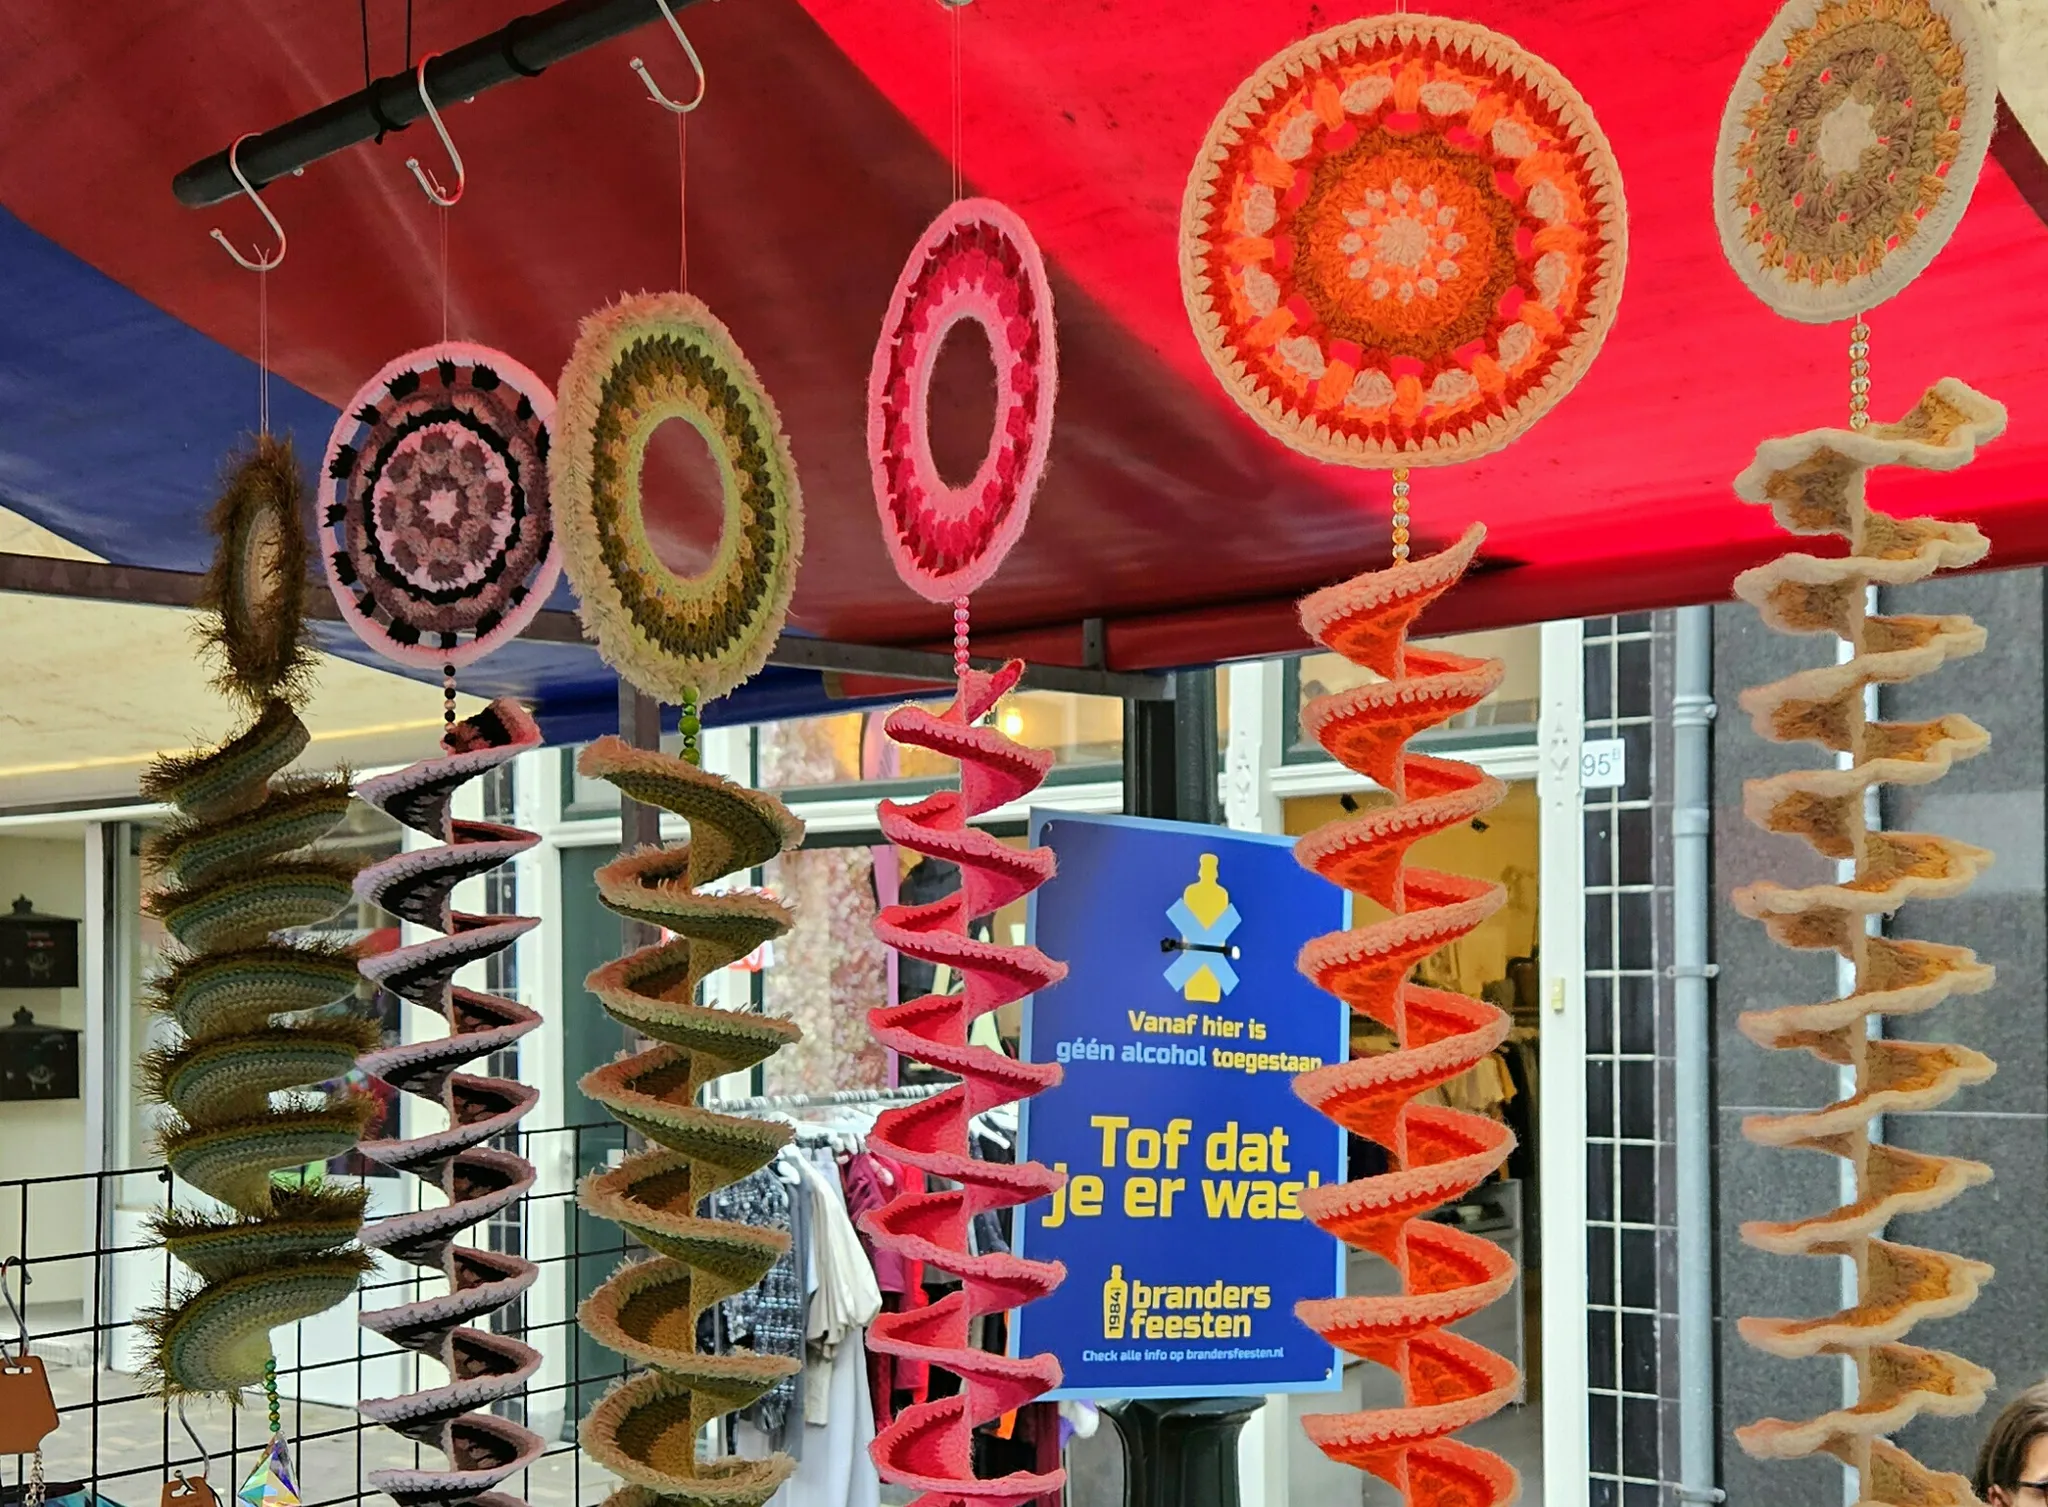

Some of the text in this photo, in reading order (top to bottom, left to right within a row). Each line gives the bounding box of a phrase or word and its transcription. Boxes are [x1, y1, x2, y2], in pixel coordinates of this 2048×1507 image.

[1128, 1010, 1266, 1040] Vanaf hier is
[1057, 1037, 1322, 1074] géén alcohol toegestaan
[1091, 1115, 1291, 1173] Tof dat
[1041, 1163, 1104, 1228] je
[1124, 1176, 1186, 1218] er
[1109, 1290, 1121, 1332] 1984
[1132, 1280, 1271, 1309] branders
[1131, 1309, 1251, 1339] feesten
[1082, 1347, 1284, 1362] Check alle info op brandersfeesten.nl
